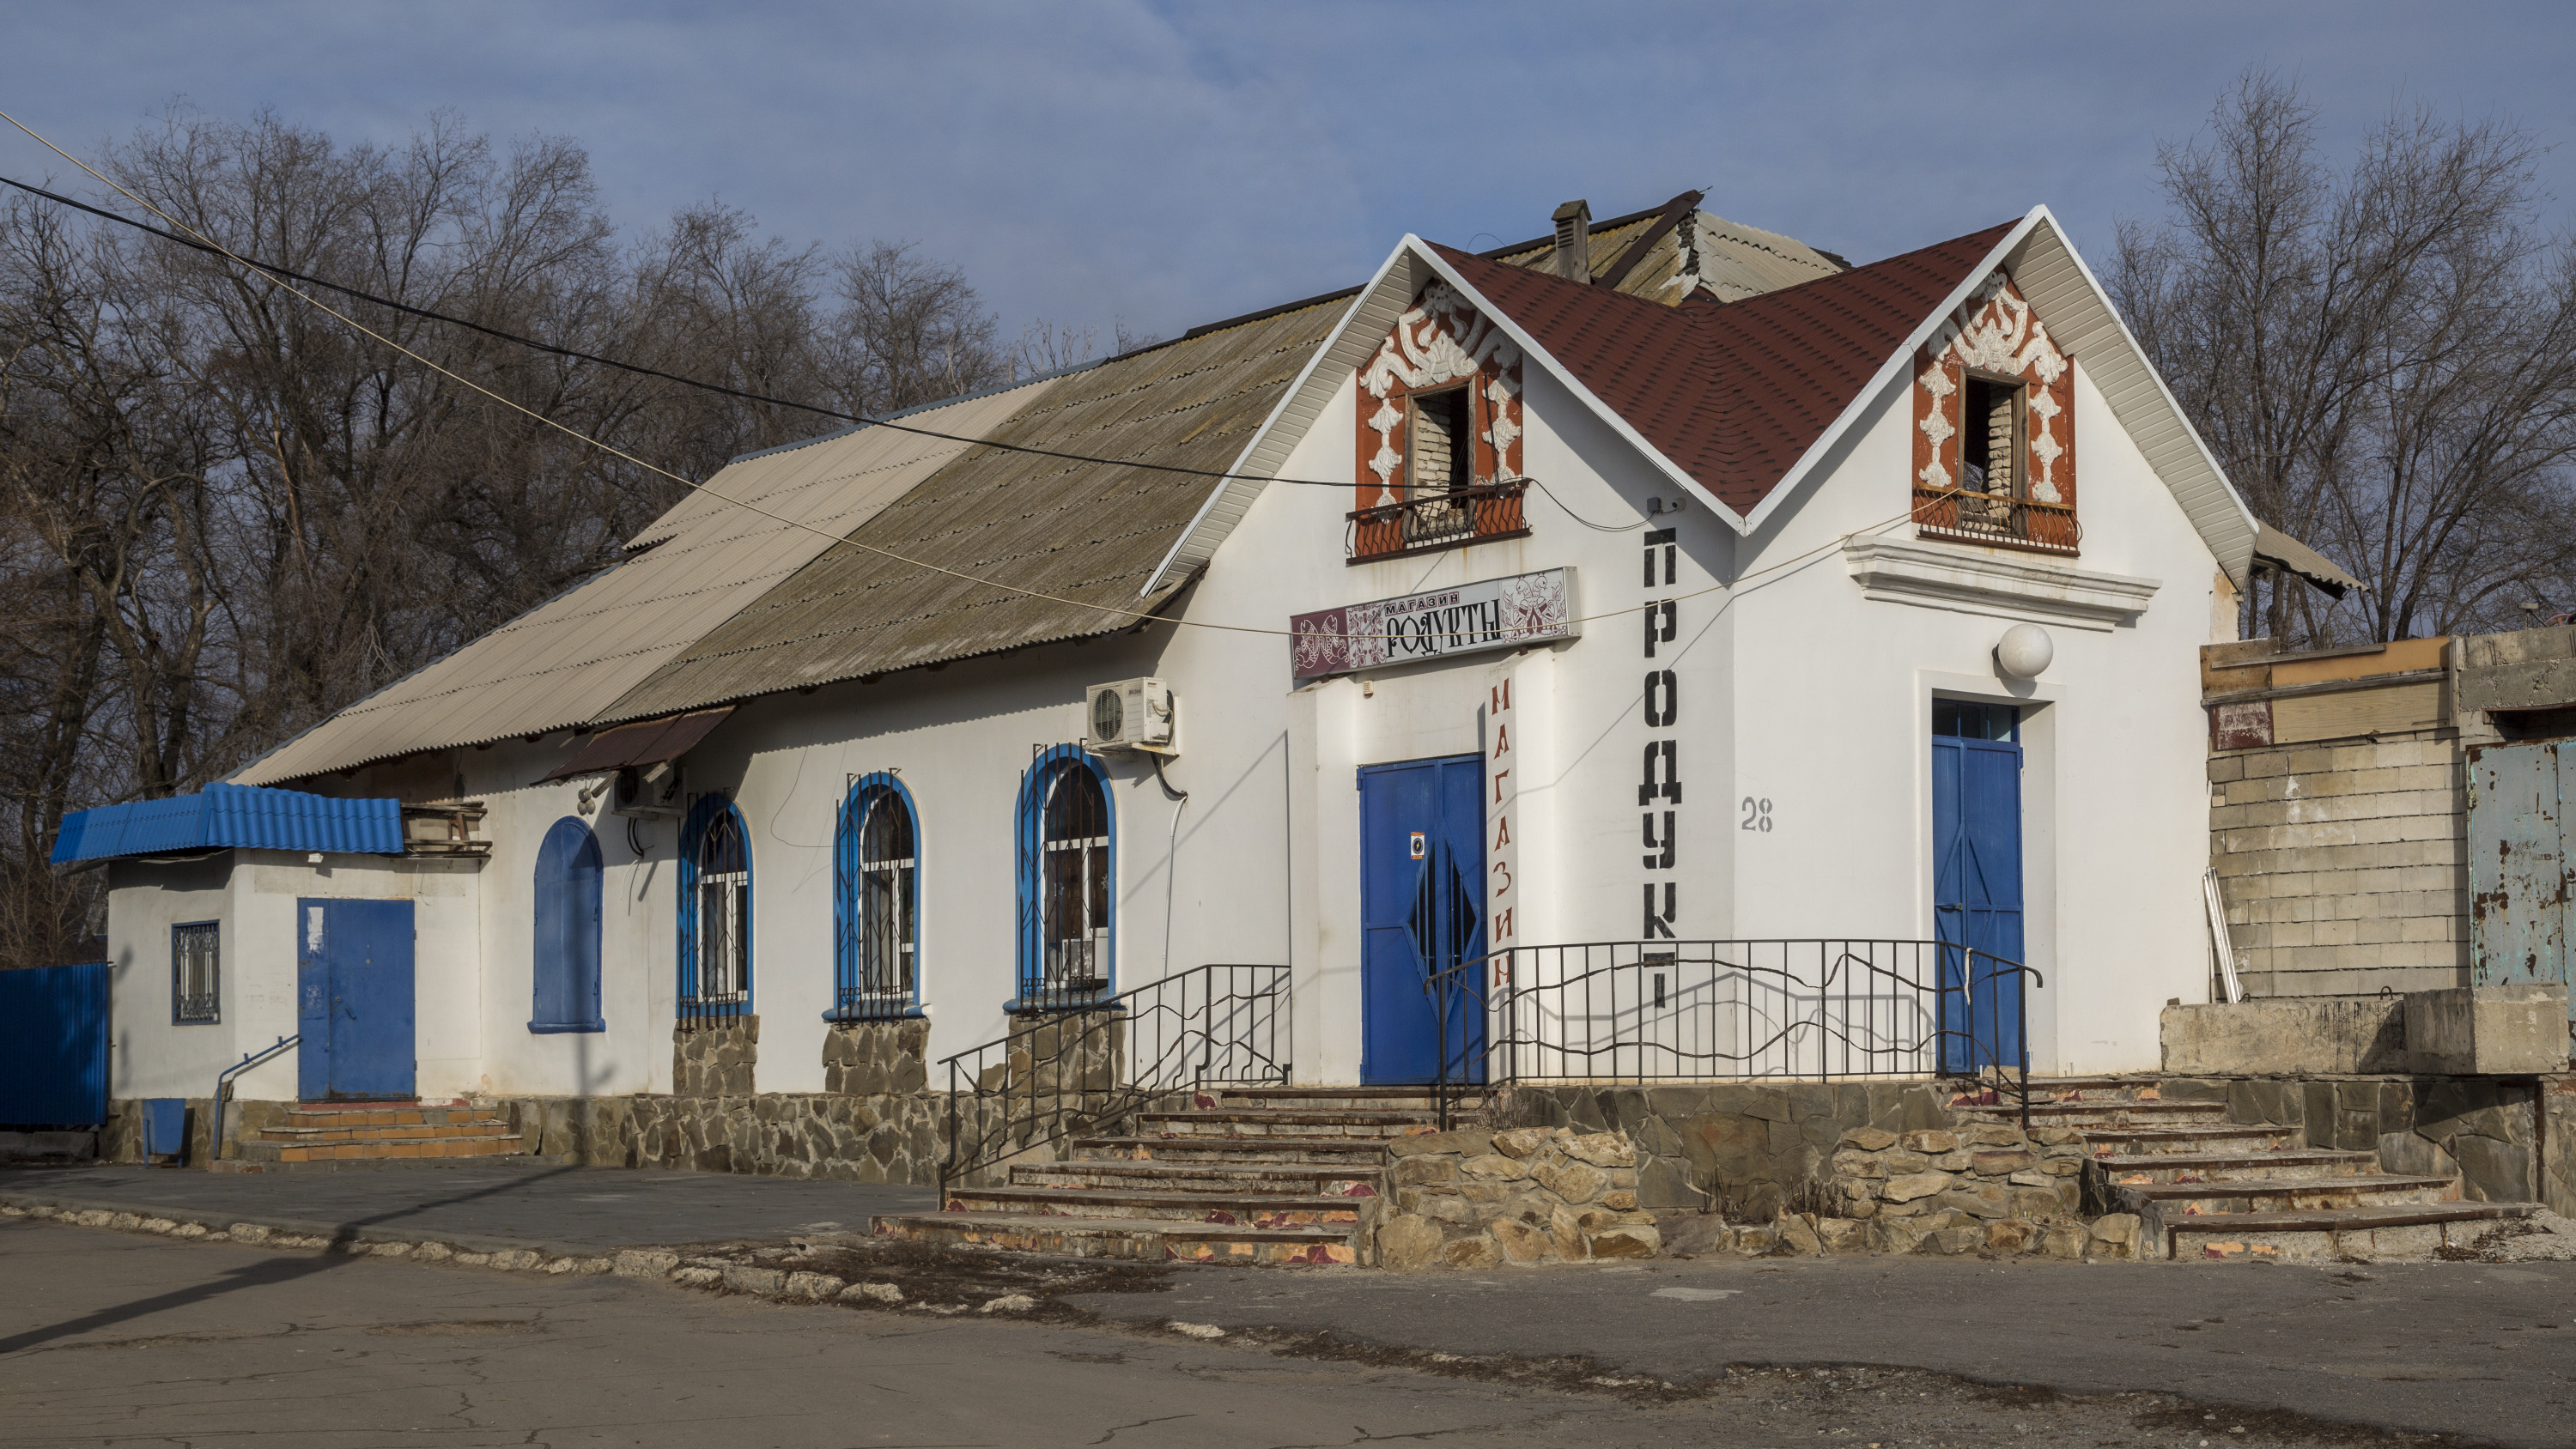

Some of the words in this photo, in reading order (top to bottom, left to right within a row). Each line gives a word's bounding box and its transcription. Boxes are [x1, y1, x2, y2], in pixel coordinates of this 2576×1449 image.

[1386, 592, 1459, 615] МАГАЗИН
[1492, 677, 1512, 988] МАГАЗИН
[1639, 527, 1682, 1009] ПРОДУКТ
[1741, 796, 1773, 833] 28
